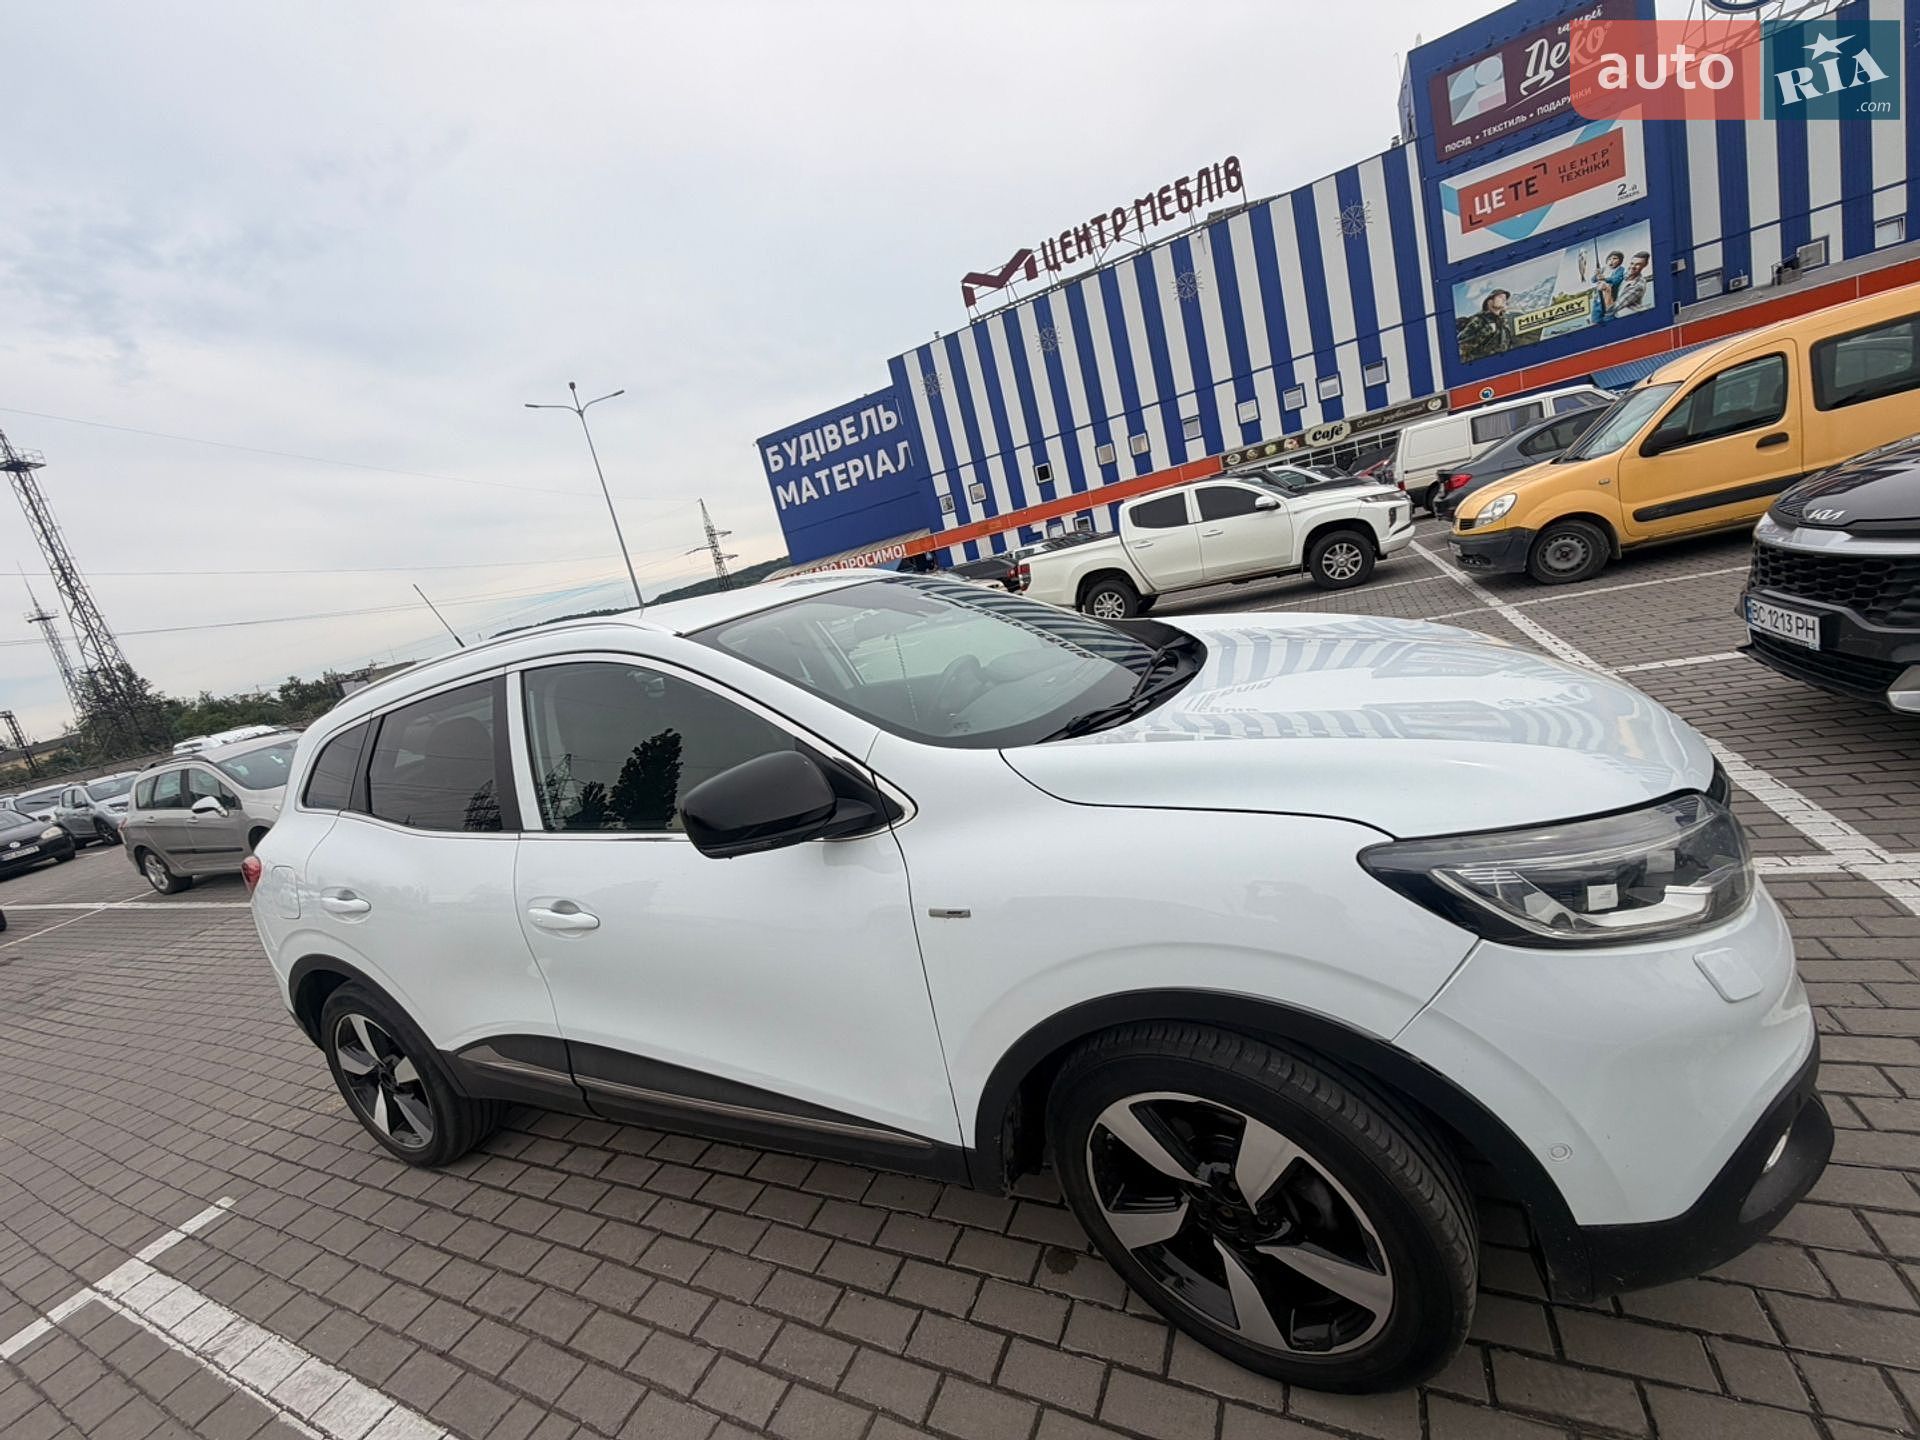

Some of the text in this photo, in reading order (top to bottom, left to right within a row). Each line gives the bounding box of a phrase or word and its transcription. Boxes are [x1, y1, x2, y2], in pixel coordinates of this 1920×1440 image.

[1519, 27, 1608, 96] Деко
[1445, 87, 1592, 153] ПОСУД ТЕКСТИЛЬ ПОДАРУНКИ
[1558, 148, 1609, 175] ЦЕНТР
[1560, 158, 1610, 184] ТЕХНІКИ
[1040, 155, 1242, 272] ЦЕНТР МЕБЛІВ
[1518, 300, 1584, 325] MILITARY
[765, 399, 904, 473] БУДІВЕЛЬ
[1312, 424, 1344, 442] Café
[1768, 608, 1793, 633] 1213
[1795, 615, 1816, 640] PH
